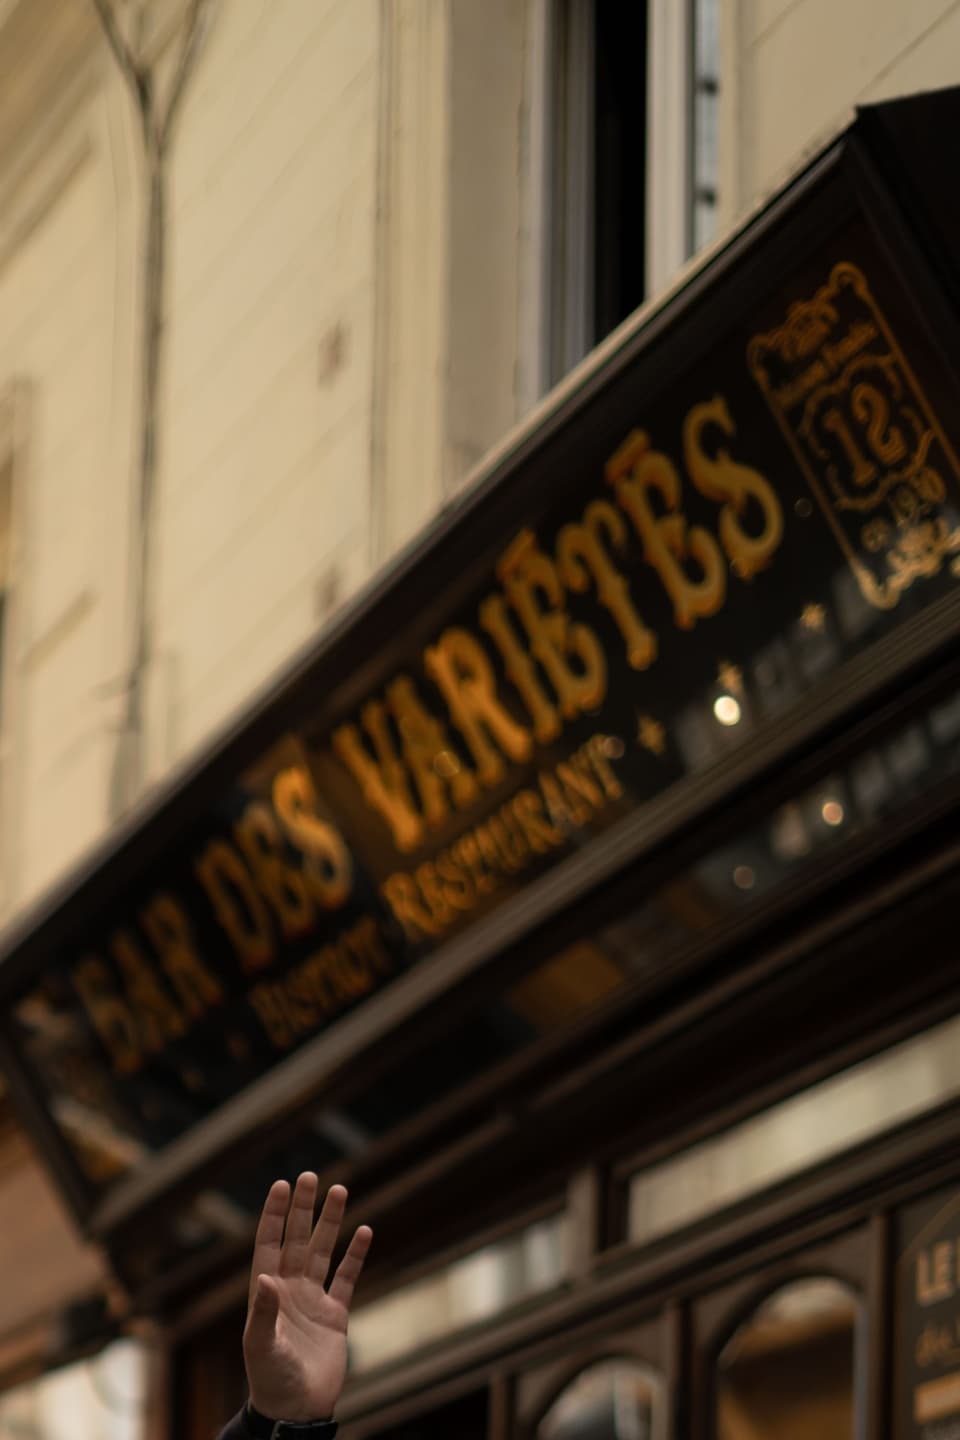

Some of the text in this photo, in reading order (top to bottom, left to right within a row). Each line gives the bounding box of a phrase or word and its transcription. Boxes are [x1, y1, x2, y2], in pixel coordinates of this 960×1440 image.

[823, 382, 906, 486] 12
[70, 890, 224, 1076] BAR
[195, 766, 351, 973] DES
[384, 734, 623, 940] RESTAURANT
